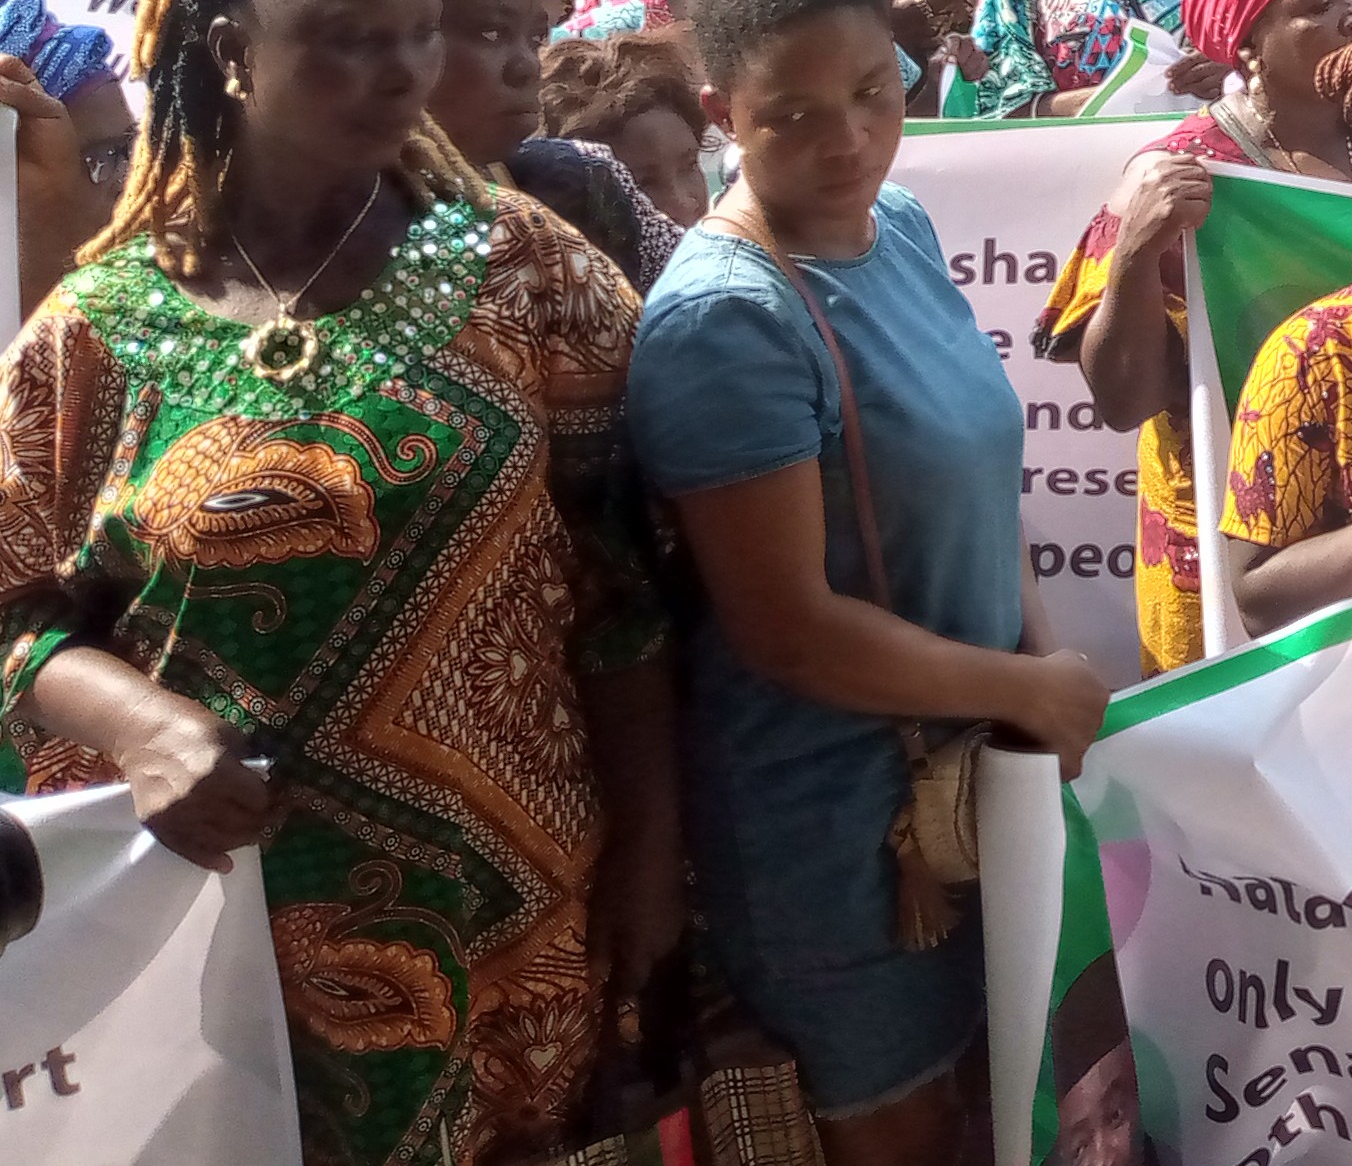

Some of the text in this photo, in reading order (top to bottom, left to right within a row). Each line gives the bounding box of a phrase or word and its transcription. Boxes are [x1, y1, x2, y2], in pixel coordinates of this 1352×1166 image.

[949, 238, 1058, 286] sha
[1021, 466, 1138, 496] rese
[1205, 957, 1343, 1031] only
[2, 1045, 82, 1111] rt
